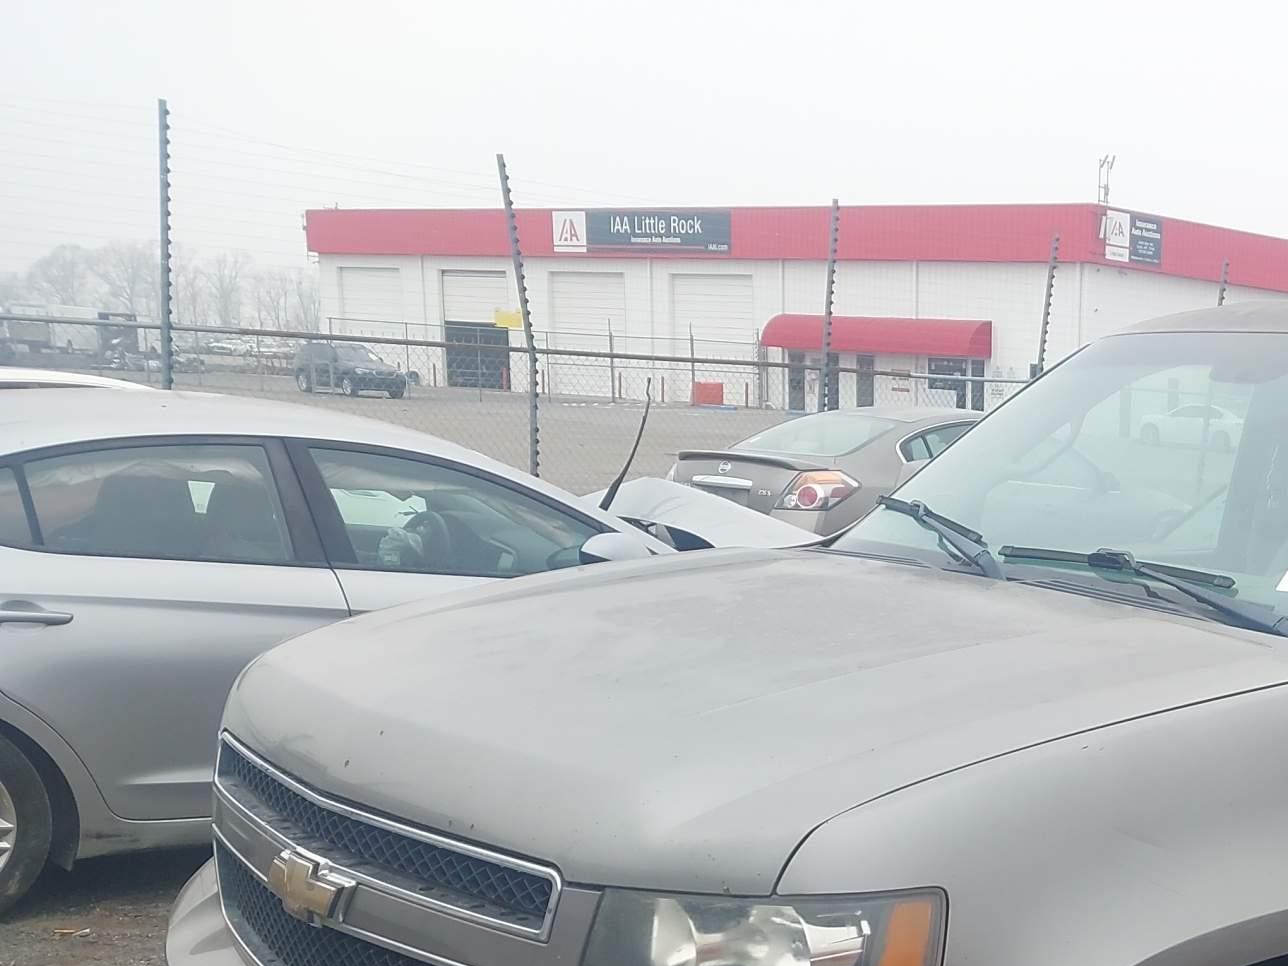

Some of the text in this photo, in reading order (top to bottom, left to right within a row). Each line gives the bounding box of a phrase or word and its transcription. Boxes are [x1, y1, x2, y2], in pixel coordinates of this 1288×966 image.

[610, 215, 702, 234] IAA Little Rock
